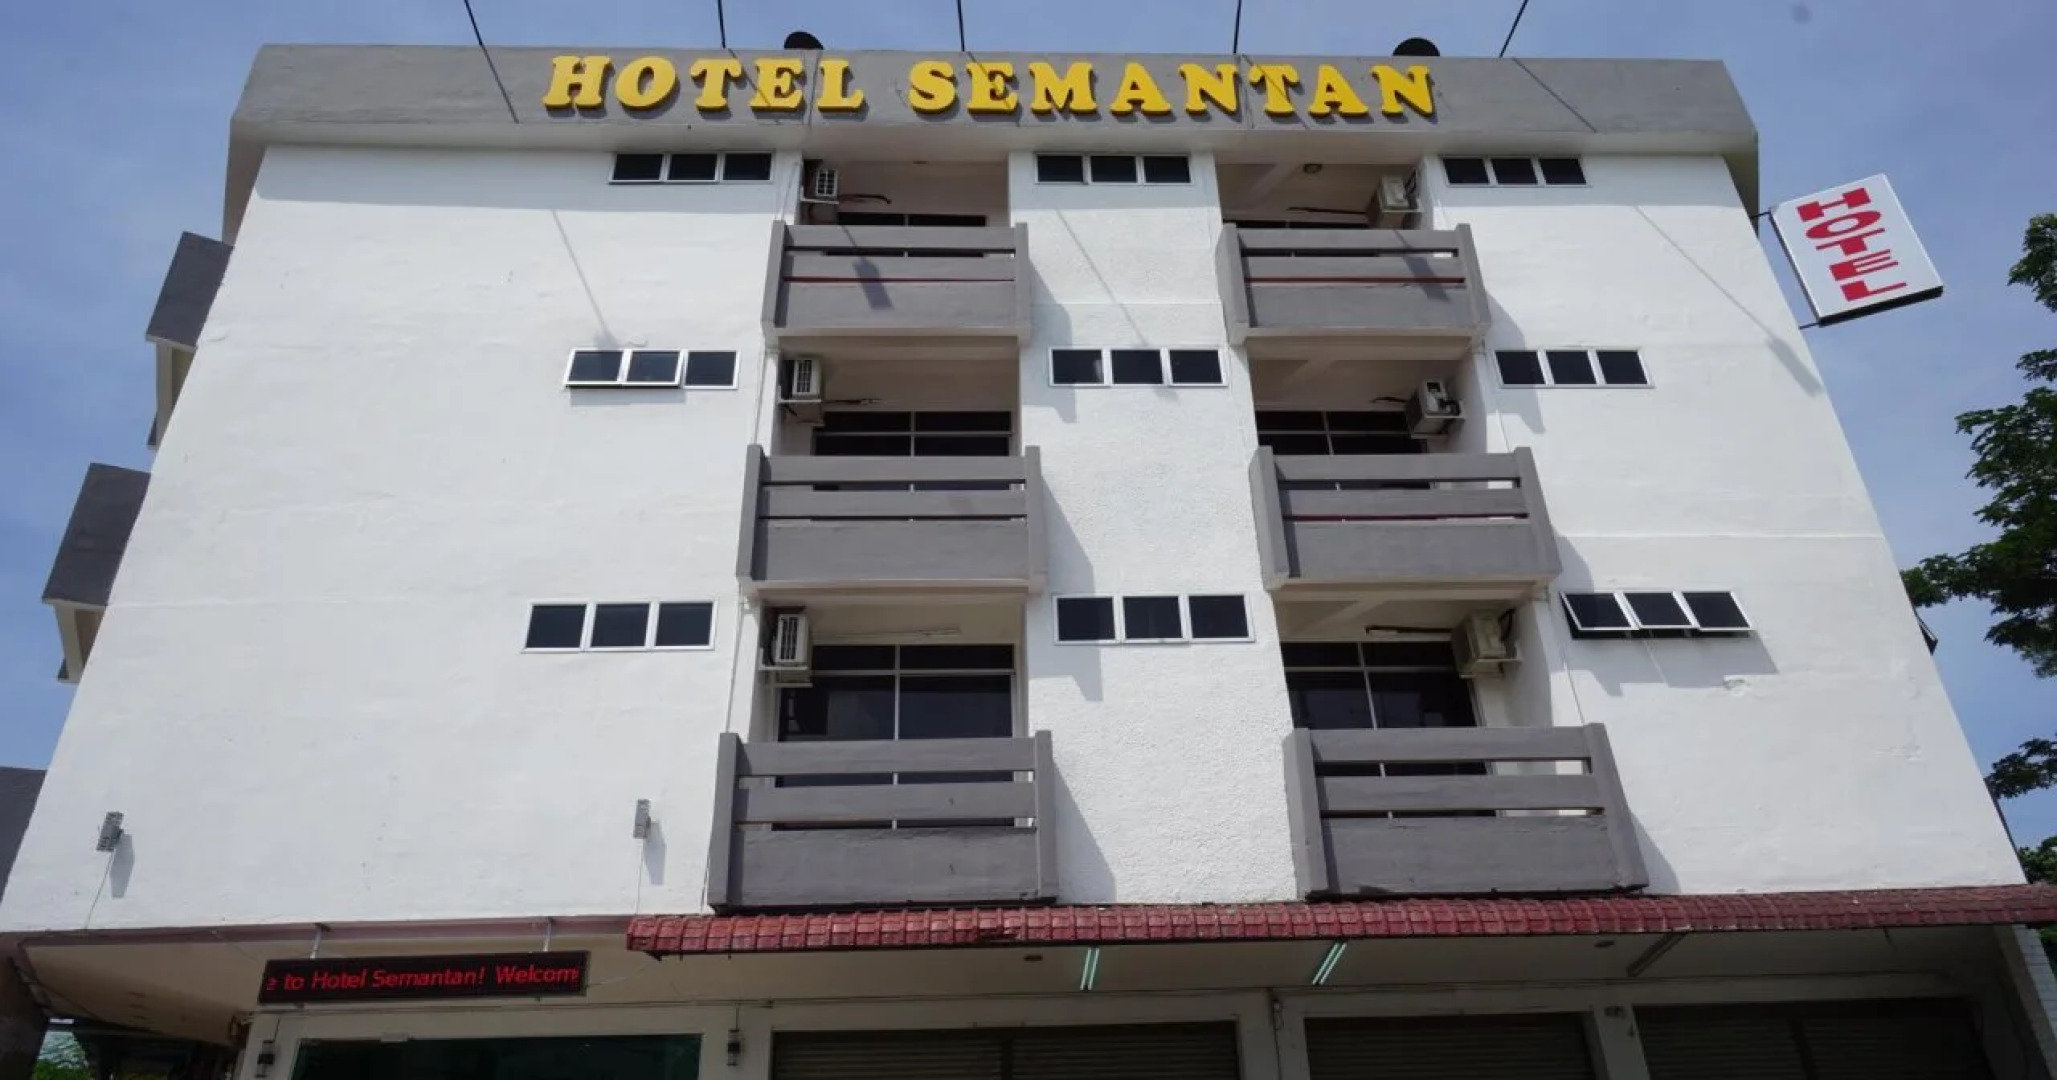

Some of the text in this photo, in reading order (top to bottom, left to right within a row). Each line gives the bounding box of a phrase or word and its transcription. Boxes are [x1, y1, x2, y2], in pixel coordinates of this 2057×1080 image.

[542, 56, 1434, 116] HOTEL SEMANTAN
[1797, 187, 1907, 302] HOTEL
[285, 973, 305, 991] to
[312, 969, 367, 989] Hotel
[372, 967, 486, 988] Semantan!
